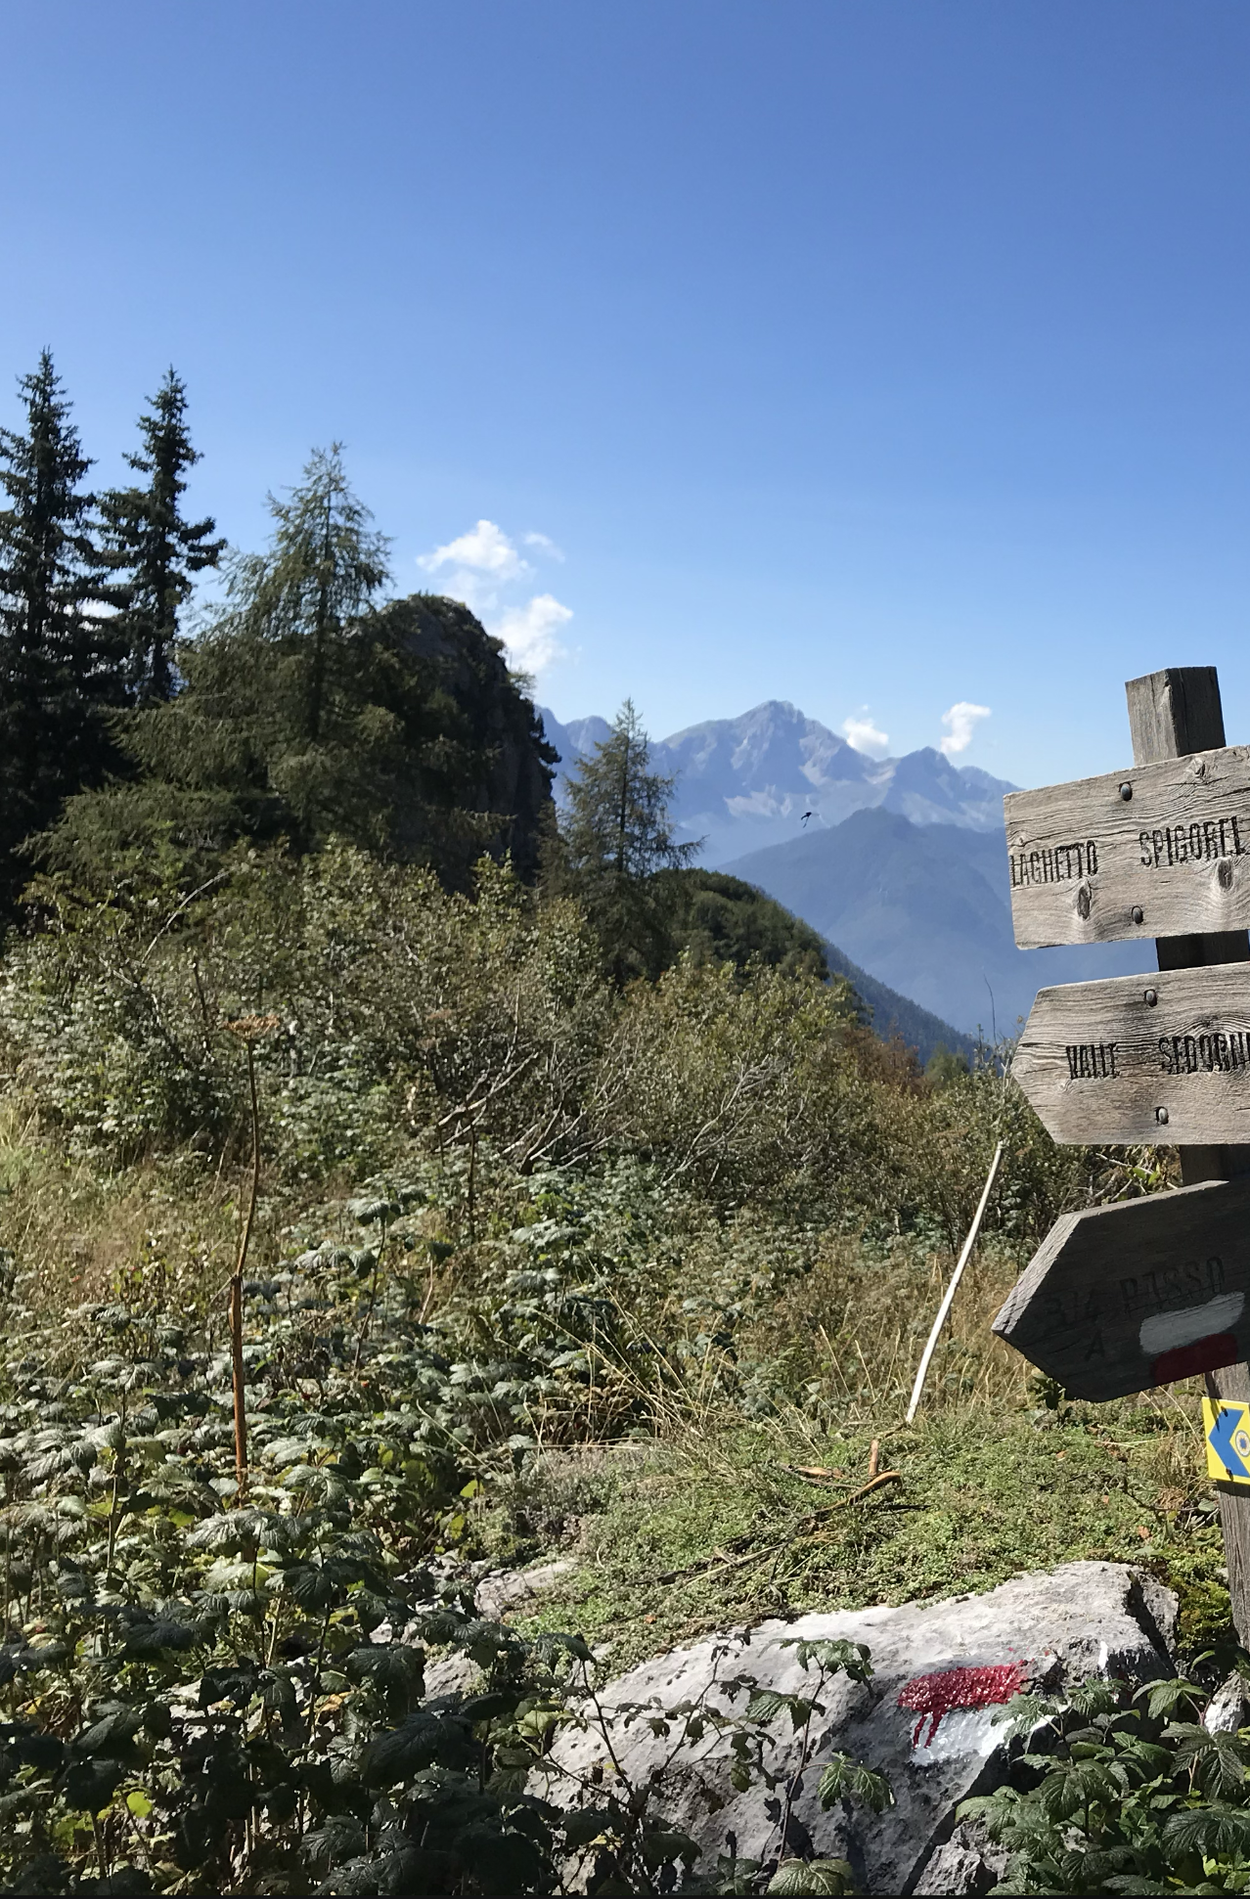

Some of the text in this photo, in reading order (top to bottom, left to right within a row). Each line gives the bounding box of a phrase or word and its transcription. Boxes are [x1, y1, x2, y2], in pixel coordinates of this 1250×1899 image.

[1007, 816, 1246, 887] LAGHETTO SPIGOREL
[1119, 1256, 1226, 1321] PASSO
